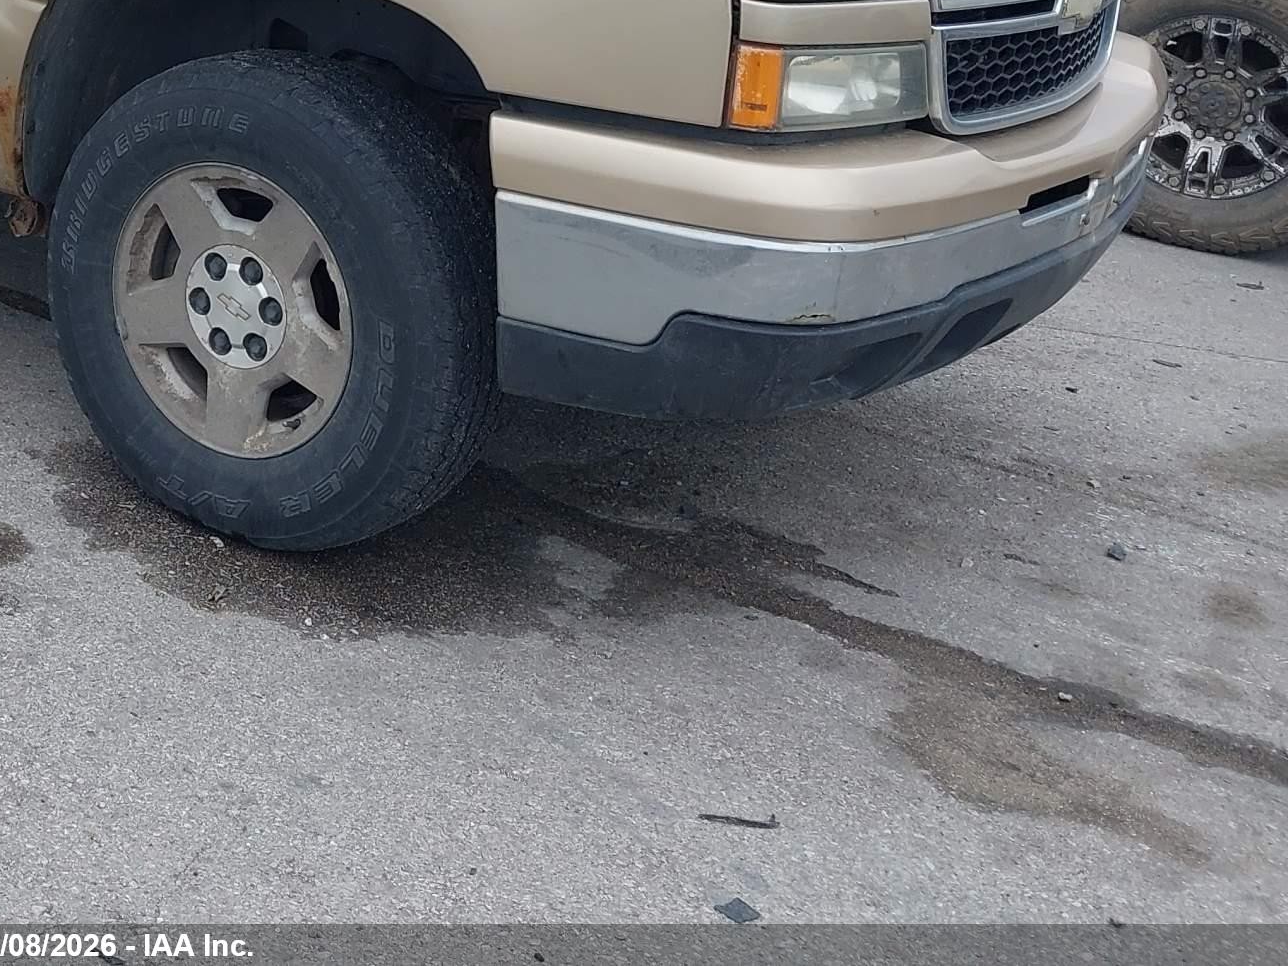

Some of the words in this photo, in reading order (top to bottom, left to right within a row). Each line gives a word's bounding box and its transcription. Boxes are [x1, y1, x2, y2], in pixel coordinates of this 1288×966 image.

[61, 105, 250, 275] BRIDGESTONE
[157, 474, 251, 519] A/T
[278, 318, 396, 519] DUELER
